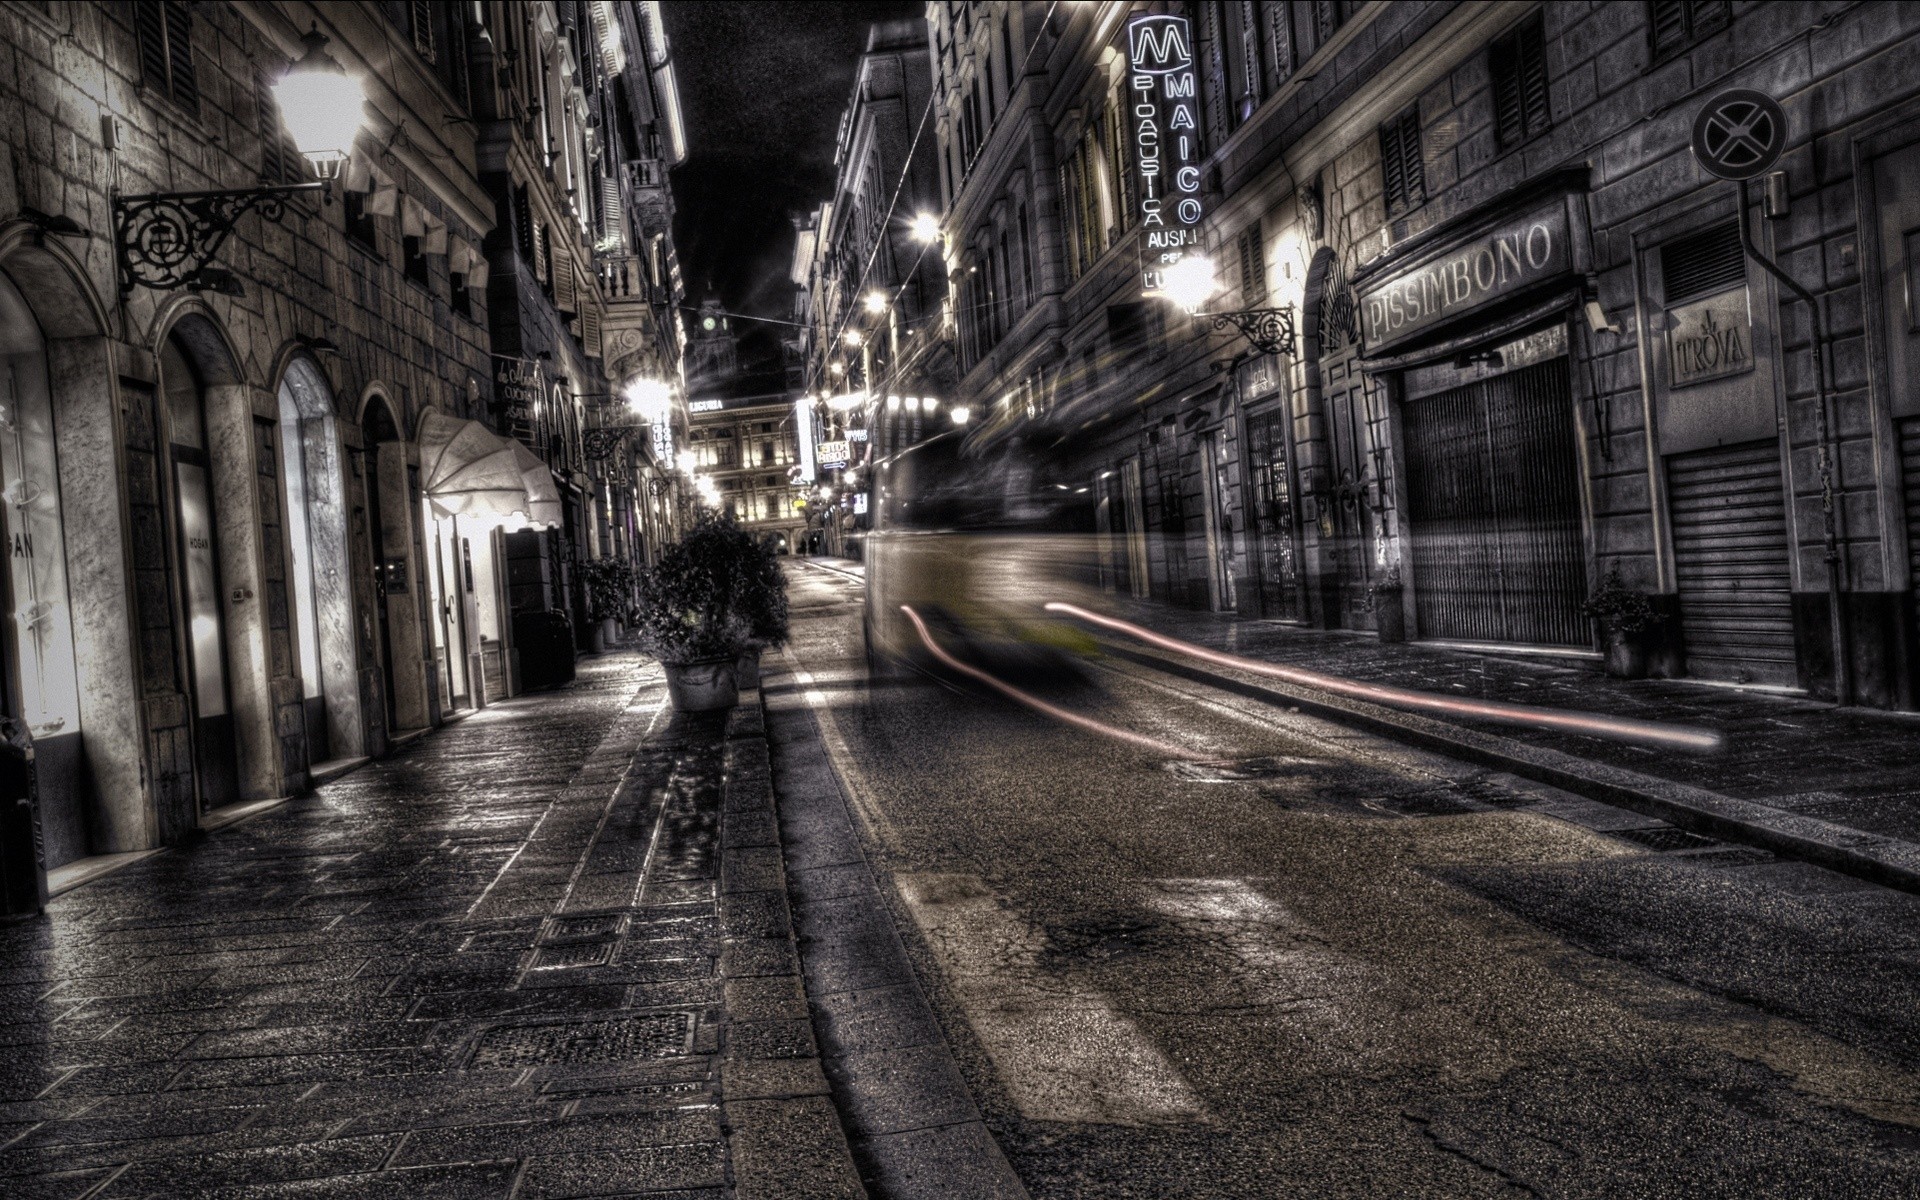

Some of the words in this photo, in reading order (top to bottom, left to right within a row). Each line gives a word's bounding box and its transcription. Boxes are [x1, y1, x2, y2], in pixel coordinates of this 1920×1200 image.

[1133, 75, 1164, 227] BIOACUSTICA
[1165, 72, 1202, 224] MAICO
[1369, 222, 1552, 340] PISSIMBONO
[189, 537, 209, 549] HOGAN
